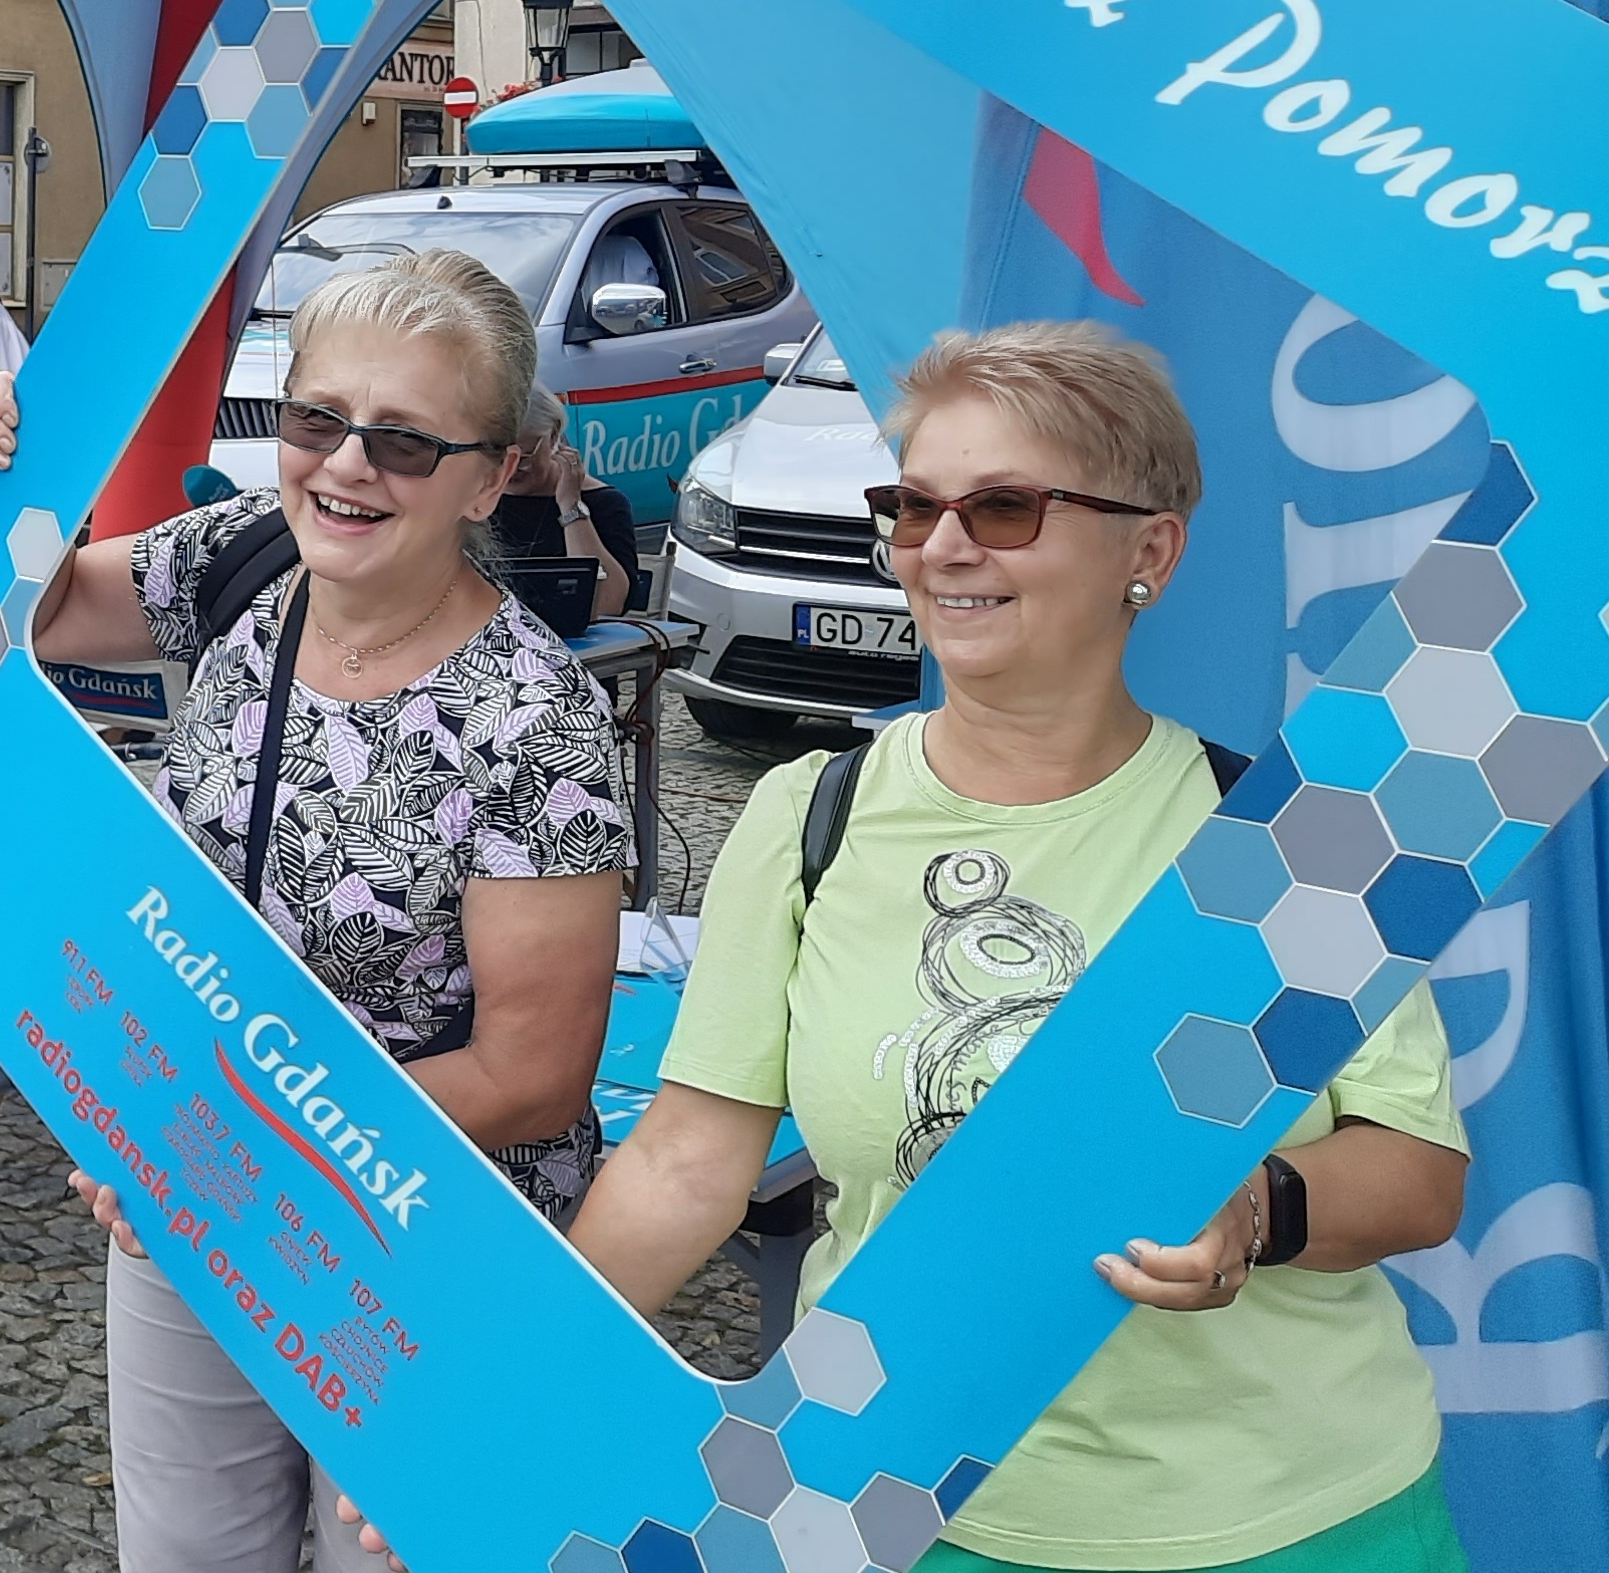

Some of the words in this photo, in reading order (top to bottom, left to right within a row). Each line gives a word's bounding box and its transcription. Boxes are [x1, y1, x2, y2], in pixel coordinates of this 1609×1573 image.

[377, 51, 454, 85] ANTOR
[583, 414, 680, 477] Radio
[797, 629, 809, 639] PL
[816, 612, 863, 645] GD
[68, 667, 158, 699] Gdańsk
[85, 968, 114, 1005] FM
[121, 1010, 148, 1047] 102
[148, 1044, 178, 1083] FM
[126, 884, 241, 1023] Radio
[243, 1012, 430, 1232] Gdańsk
[230, 1141, 262, 1182] FM
[15, 1009, 211, 1252] radiogdansk.pl
[207, 1249, 276, 1334] oraz
[274, 1322, 362, 1428] DAB+
[275, 1193, 304, 1232] 106
[306, 1230, 341, 1273] FM
[349, 1278, 383, 1315] 107
[382, 1316, 419, 1361] FM
